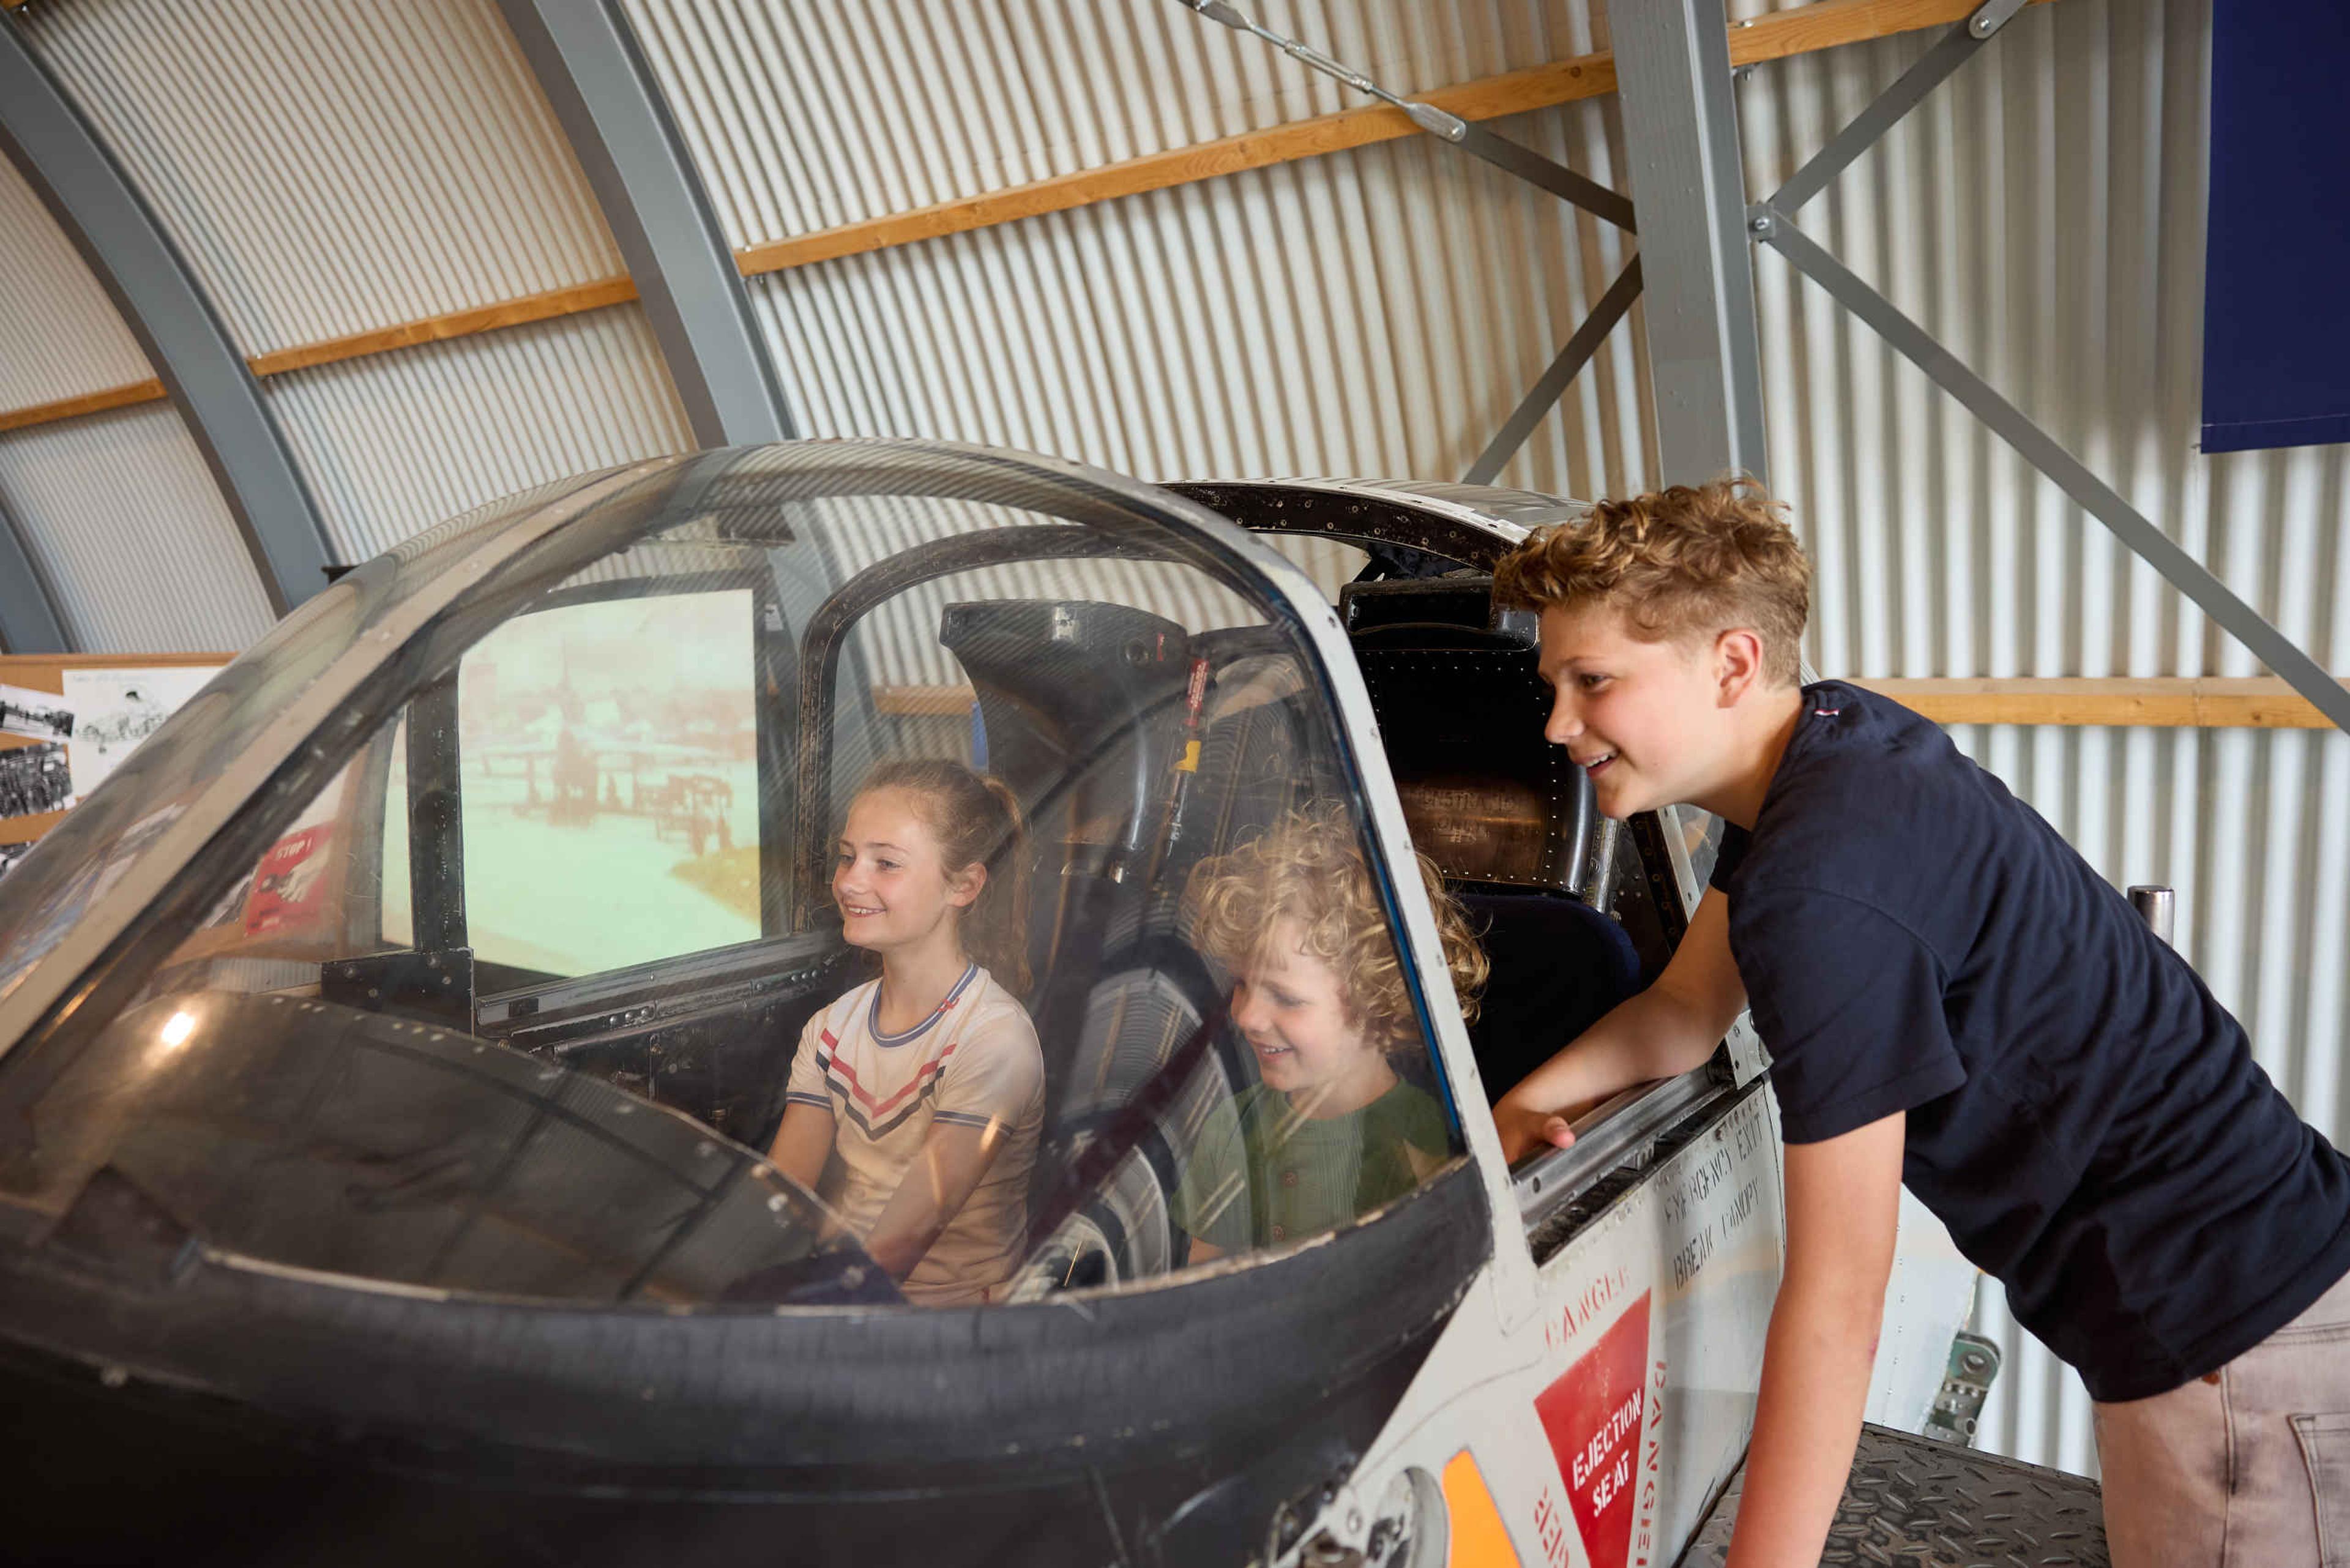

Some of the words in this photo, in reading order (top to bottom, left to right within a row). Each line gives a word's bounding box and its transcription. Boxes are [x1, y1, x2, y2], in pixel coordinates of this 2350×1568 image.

[1664, 1147, 1733, 1225] EMERGENCY
[1736, 1113, 1762, 1161] EXIT
[1674, 1225, 1713, 1291] BREAK
[1721, 1176, 1761, 1239] CANOPY
[1572, 1387, 1641, 1491] EJECTION
[1592, 1449, 1629, 1518] SEAT
